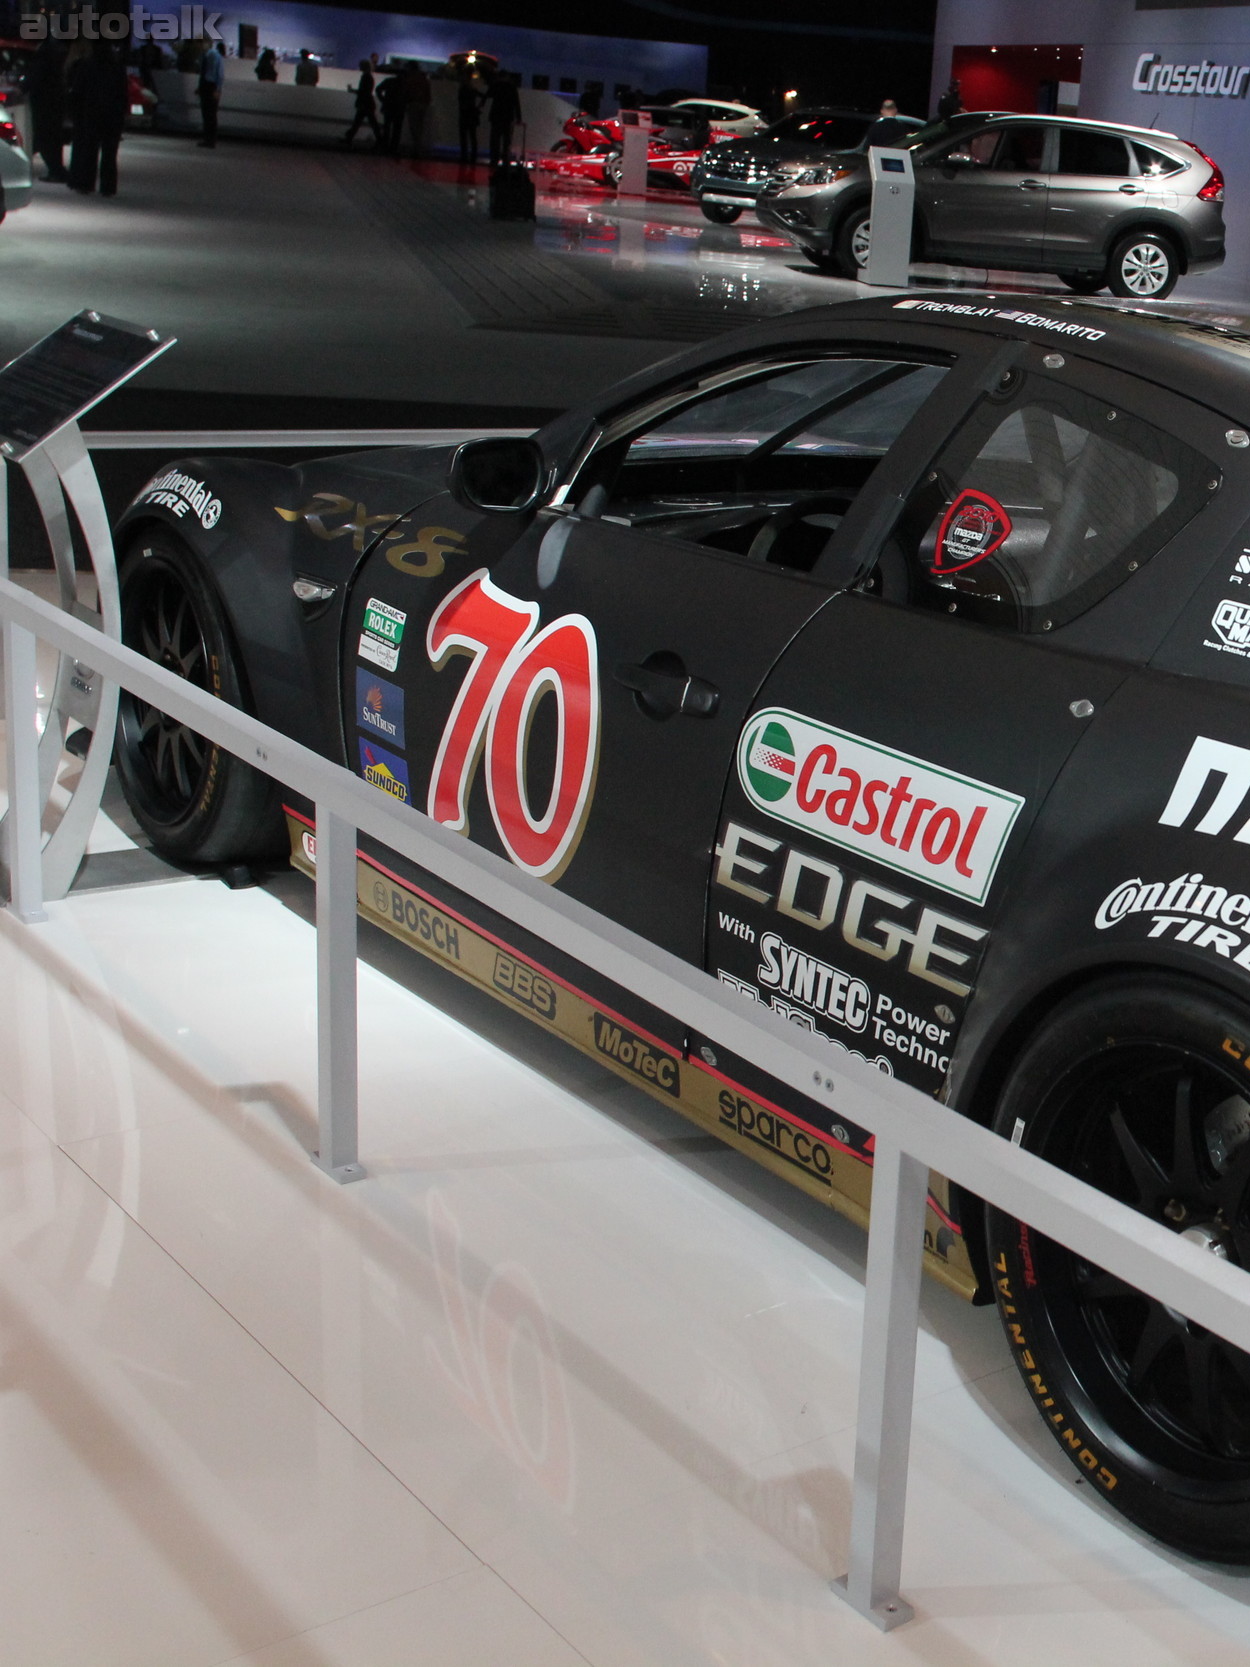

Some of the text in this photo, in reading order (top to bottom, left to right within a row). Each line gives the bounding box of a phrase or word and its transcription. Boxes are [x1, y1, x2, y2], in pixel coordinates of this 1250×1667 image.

[916, 300, 1106, 341] TREMBLAY BOMARITO
[145, 490, 190, 518] TIRE
[954, 527, 984, 541] mazda
[368, 612, 397, 639] ROLEX
[427, 567, 602, 886] 70
[367, 767, 406, 800] SUNOCO
[796, 744, 989, 879] Castrol
[391, 891, 461, 960] BOSCH
[707, 821, 993, 999] EDGE
[493, 952, 557, 1021] BBS
[718, 911, 756, 944] With
[757, 931, 872, 1034] SYNTEC
[876, 993, 951, 1046] Power
[597, 1020, 676, 1089] MoTeC
[718, 1089, 833, 1175] sparco
[994, 1252, 1118, 1491] CONTINENTAL
